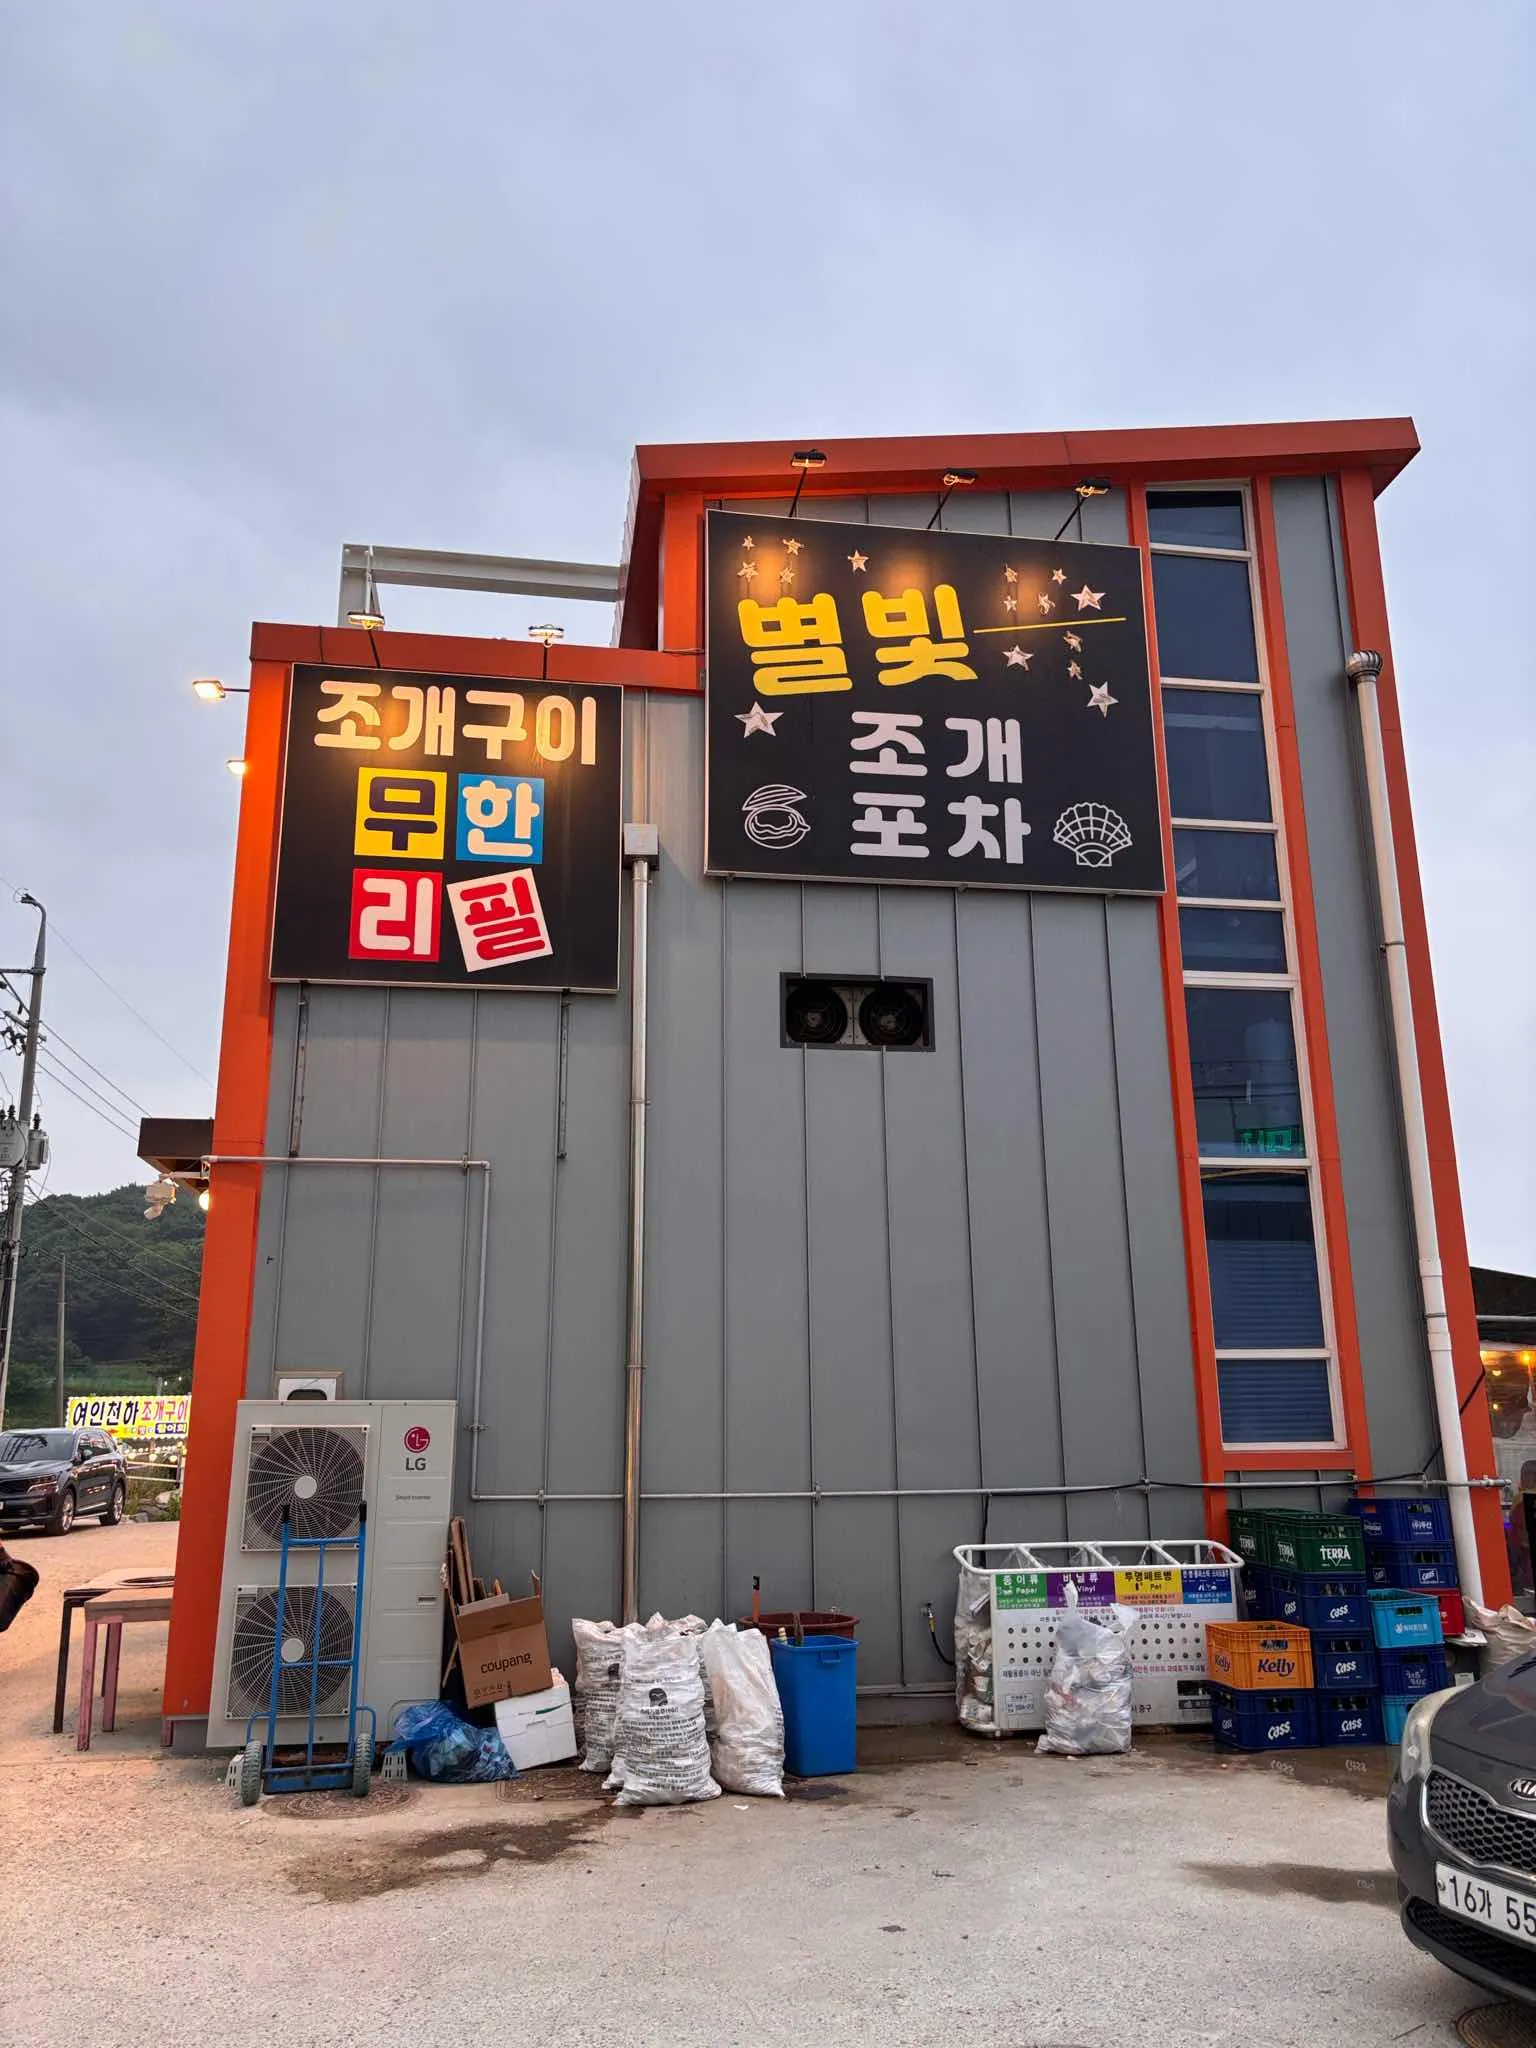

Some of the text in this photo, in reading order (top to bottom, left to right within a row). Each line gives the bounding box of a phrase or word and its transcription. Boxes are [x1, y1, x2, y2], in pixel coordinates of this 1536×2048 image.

[738, 584, 978, 696] 별빛
[314, 680, 597, 765] 조개구이
[849, 710, 1023, 784] 조개
[364, 776, 540, 857] 무한
[849, 791, 1031, 864] 포차
[358, 876, 546, 961] 리필
[73, 1400, 189, 1426] 여인천하 조개구이
[405, 1457, 427, 1471] LG
[1320, 1545, 1351, 1560] TERRA
[1125, 1570, 1172, 1581] 투명페트병
[1077, 1585, 1096, 1593] Vinyl
[1284, 1600, 1297, 1615] Cass
[1330, 1604, 1348, 1619] Cass
[480, 1652, 533, 1674] coupang
[1257, 1658, 1295, 1676] Kelly
[1335, 1660, 1357, 1675] Cass
[1267, 1720, 1291, 1740] Cass
[1341, 1718, 1362, 1733] Cass
[1449, 1875, 1492, 1919] 16가
